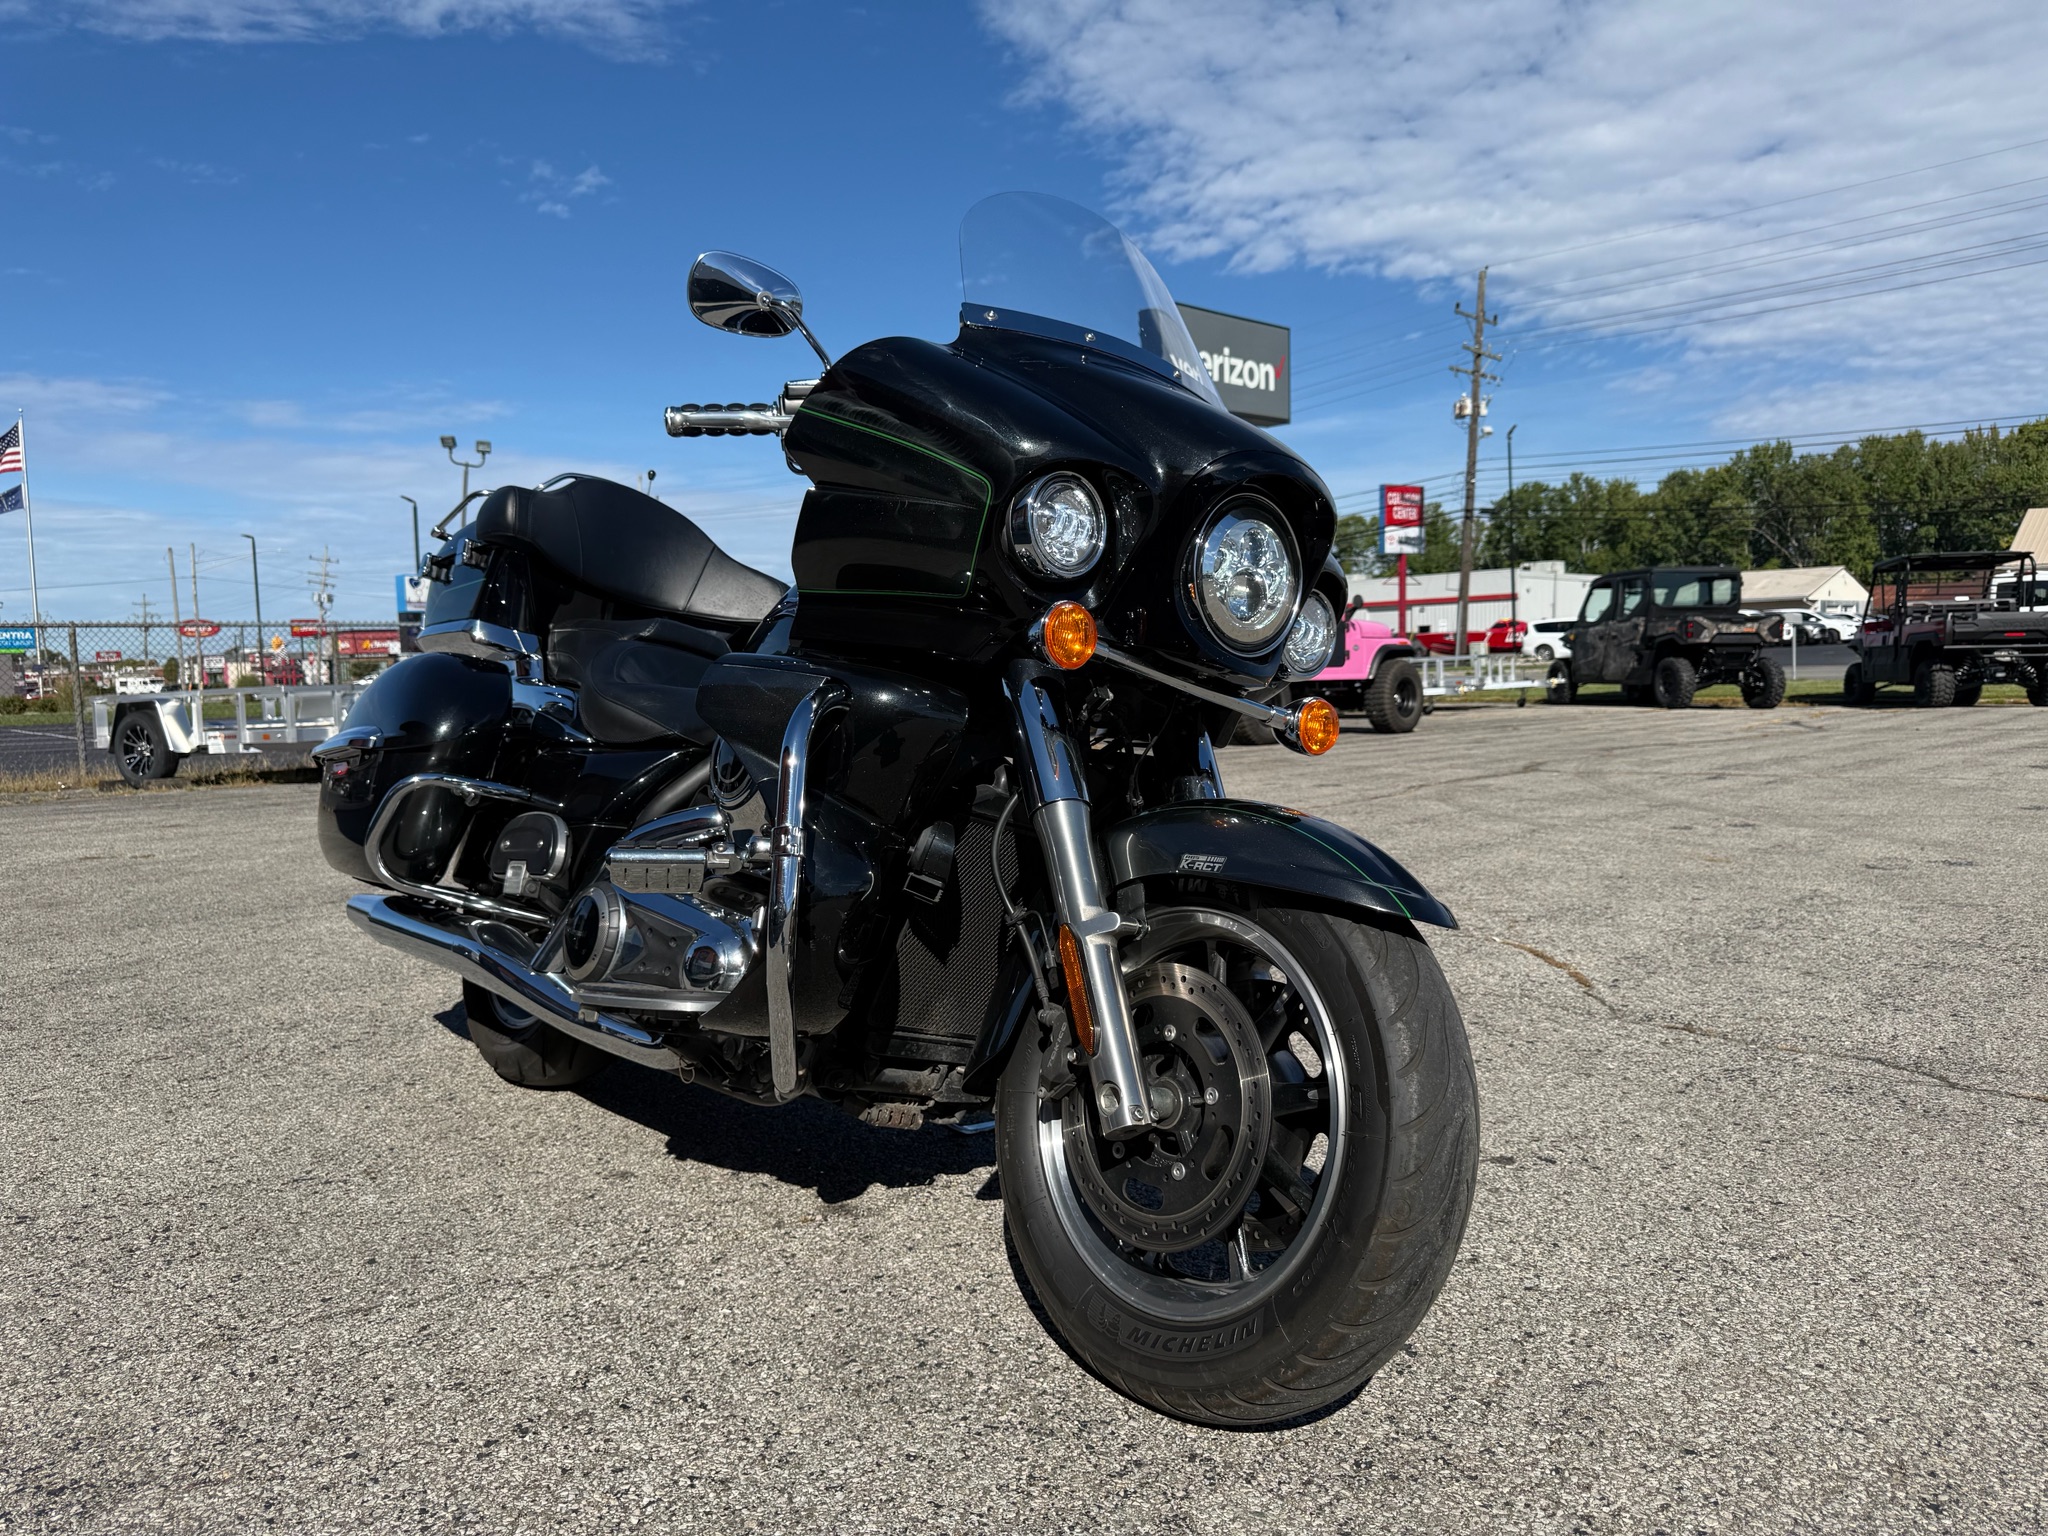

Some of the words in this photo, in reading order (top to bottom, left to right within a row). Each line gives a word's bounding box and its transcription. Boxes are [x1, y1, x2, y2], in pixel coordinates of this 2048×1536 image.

[1199, 346, 1275, 391] erizon
[1392, 506, 1418, 520] CENTER
[1179, 859, 1223, 872] K-ACT
[1126, 1318, 1258, 1353] MICHELIN
